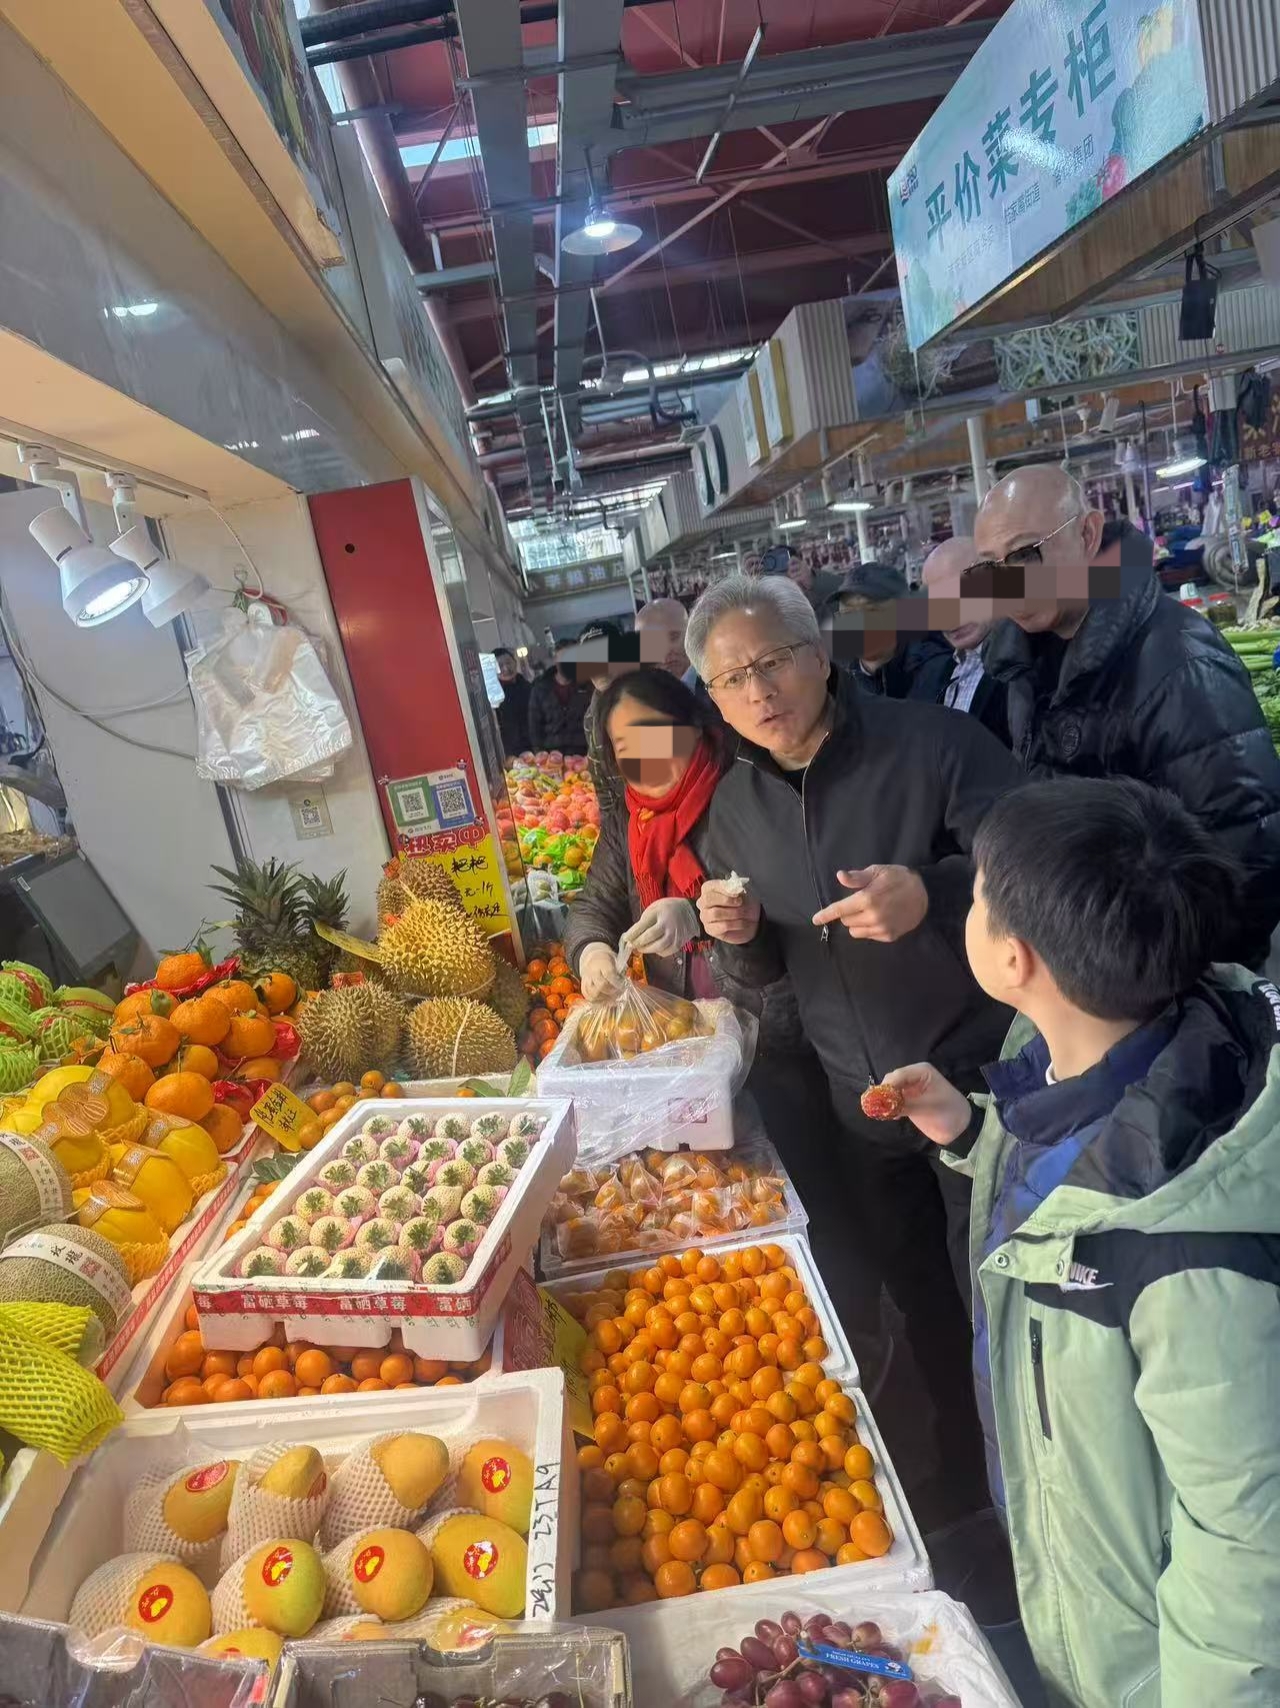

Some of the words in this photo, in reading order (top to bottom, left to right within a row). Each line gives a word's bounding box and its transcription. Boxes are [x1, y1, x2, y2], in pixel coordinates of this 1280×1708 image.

[925, 0, 1116, 250] 平价菜专柜
[825, 1652, 850, 1663] FRESH
[851, 1658, 880, 1670] GRAPES
